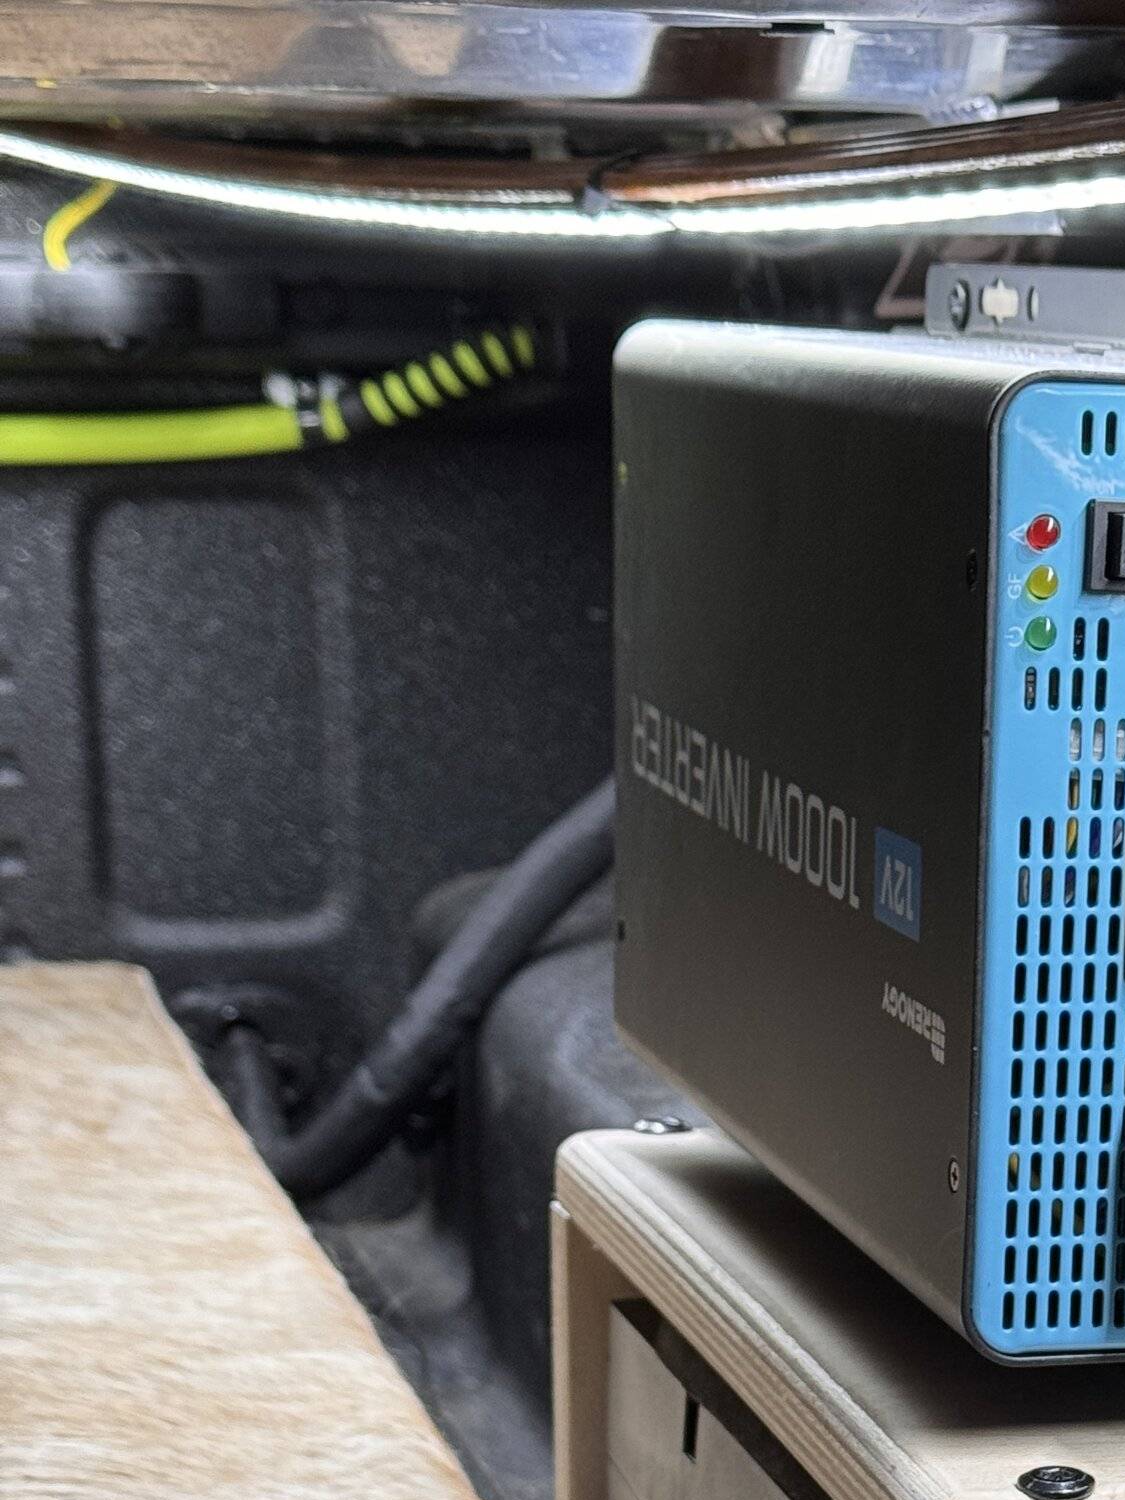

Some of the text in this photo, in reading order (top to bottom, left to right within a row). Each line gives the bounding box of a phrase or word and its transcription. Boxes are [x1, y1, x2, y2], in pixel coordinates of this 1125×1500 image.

[630, 695, 915, 922] 12V 1000W INVERTER
